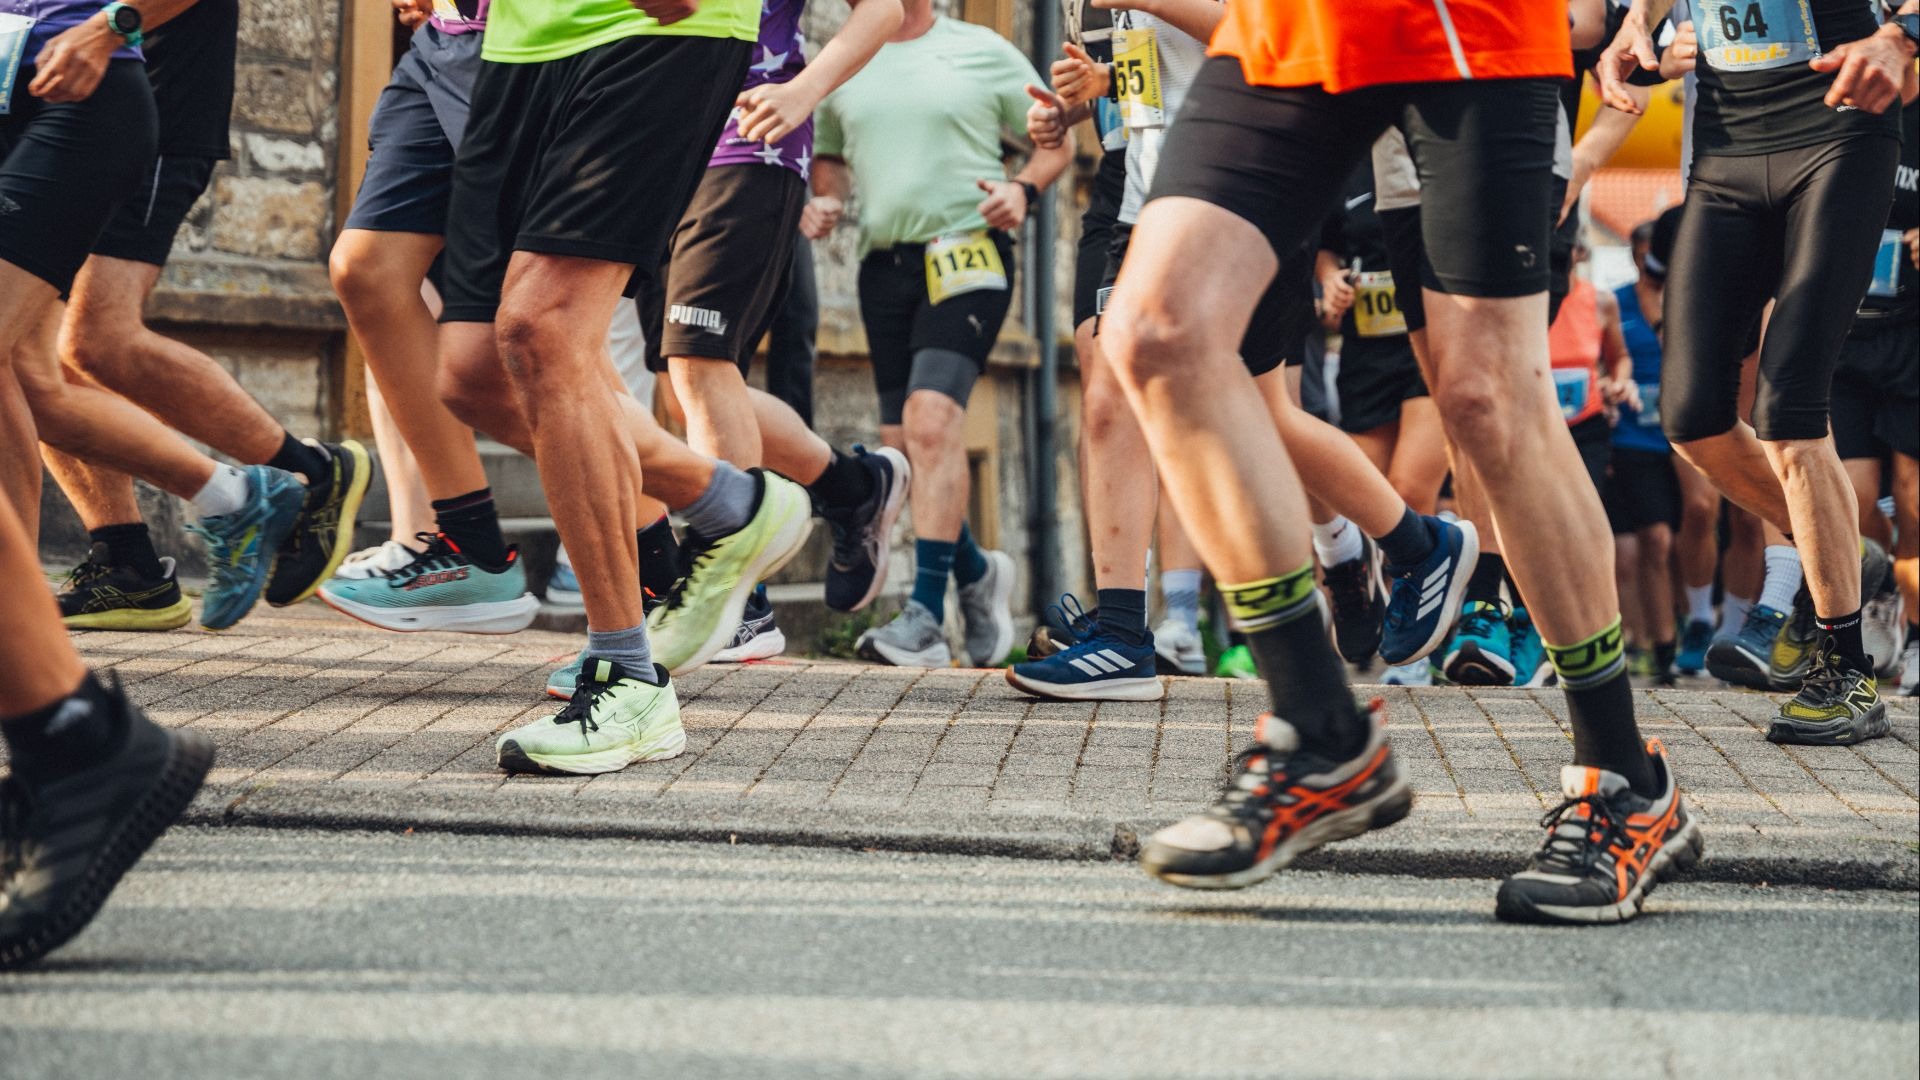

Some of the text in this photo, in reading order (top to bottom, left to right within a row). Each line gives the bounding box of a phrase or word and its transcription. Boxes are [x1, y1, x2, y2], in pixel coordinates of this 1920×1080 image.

[1719, 3, 1768, 41] 64
[930, 247, 989, 278] 1121
[669, 304, 722, 329] PUMA
[1362, 290, 1397, 315] 10
